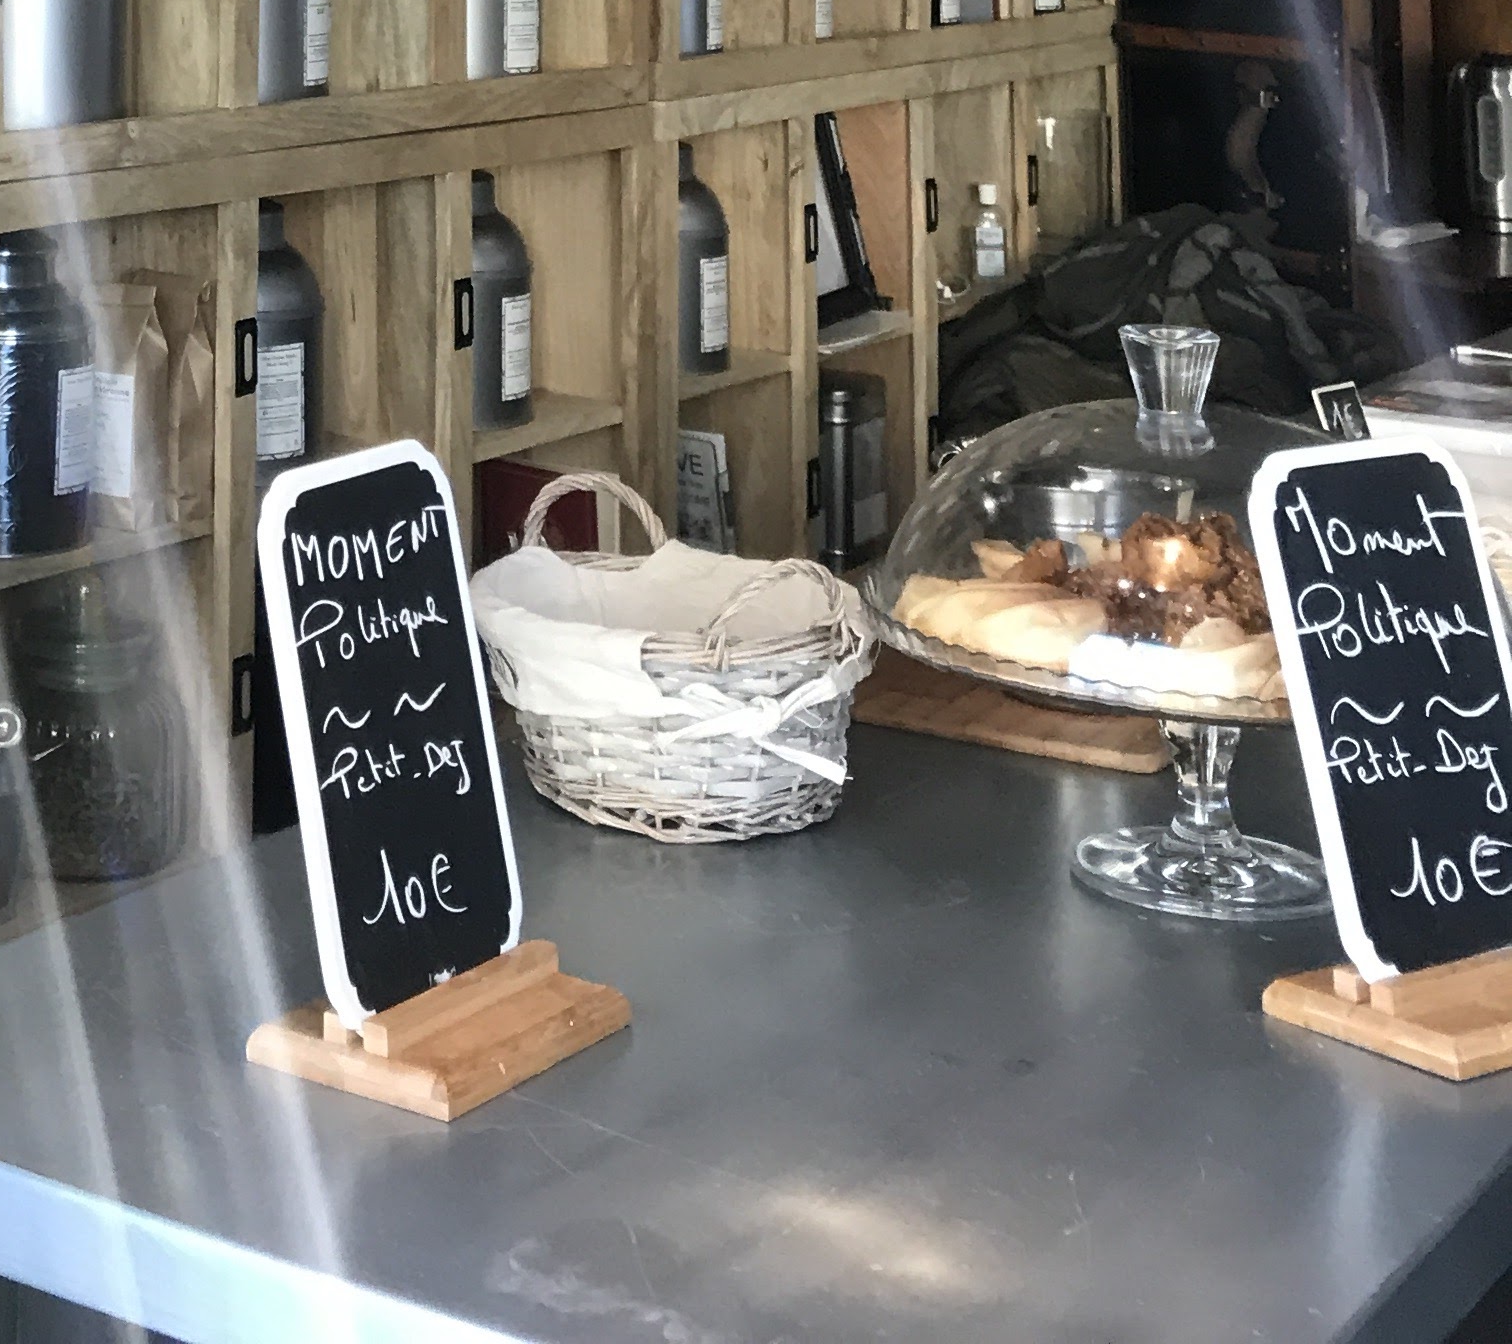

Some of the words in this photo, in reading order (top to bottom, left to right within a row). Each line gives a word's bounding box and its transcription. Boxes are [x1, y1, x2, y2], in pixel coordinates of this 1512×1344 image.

[290, 505, 447, 586] MOMENT
[1285, 486, 1465, 574] Moment
[362, 849, 468, 924] 10€
